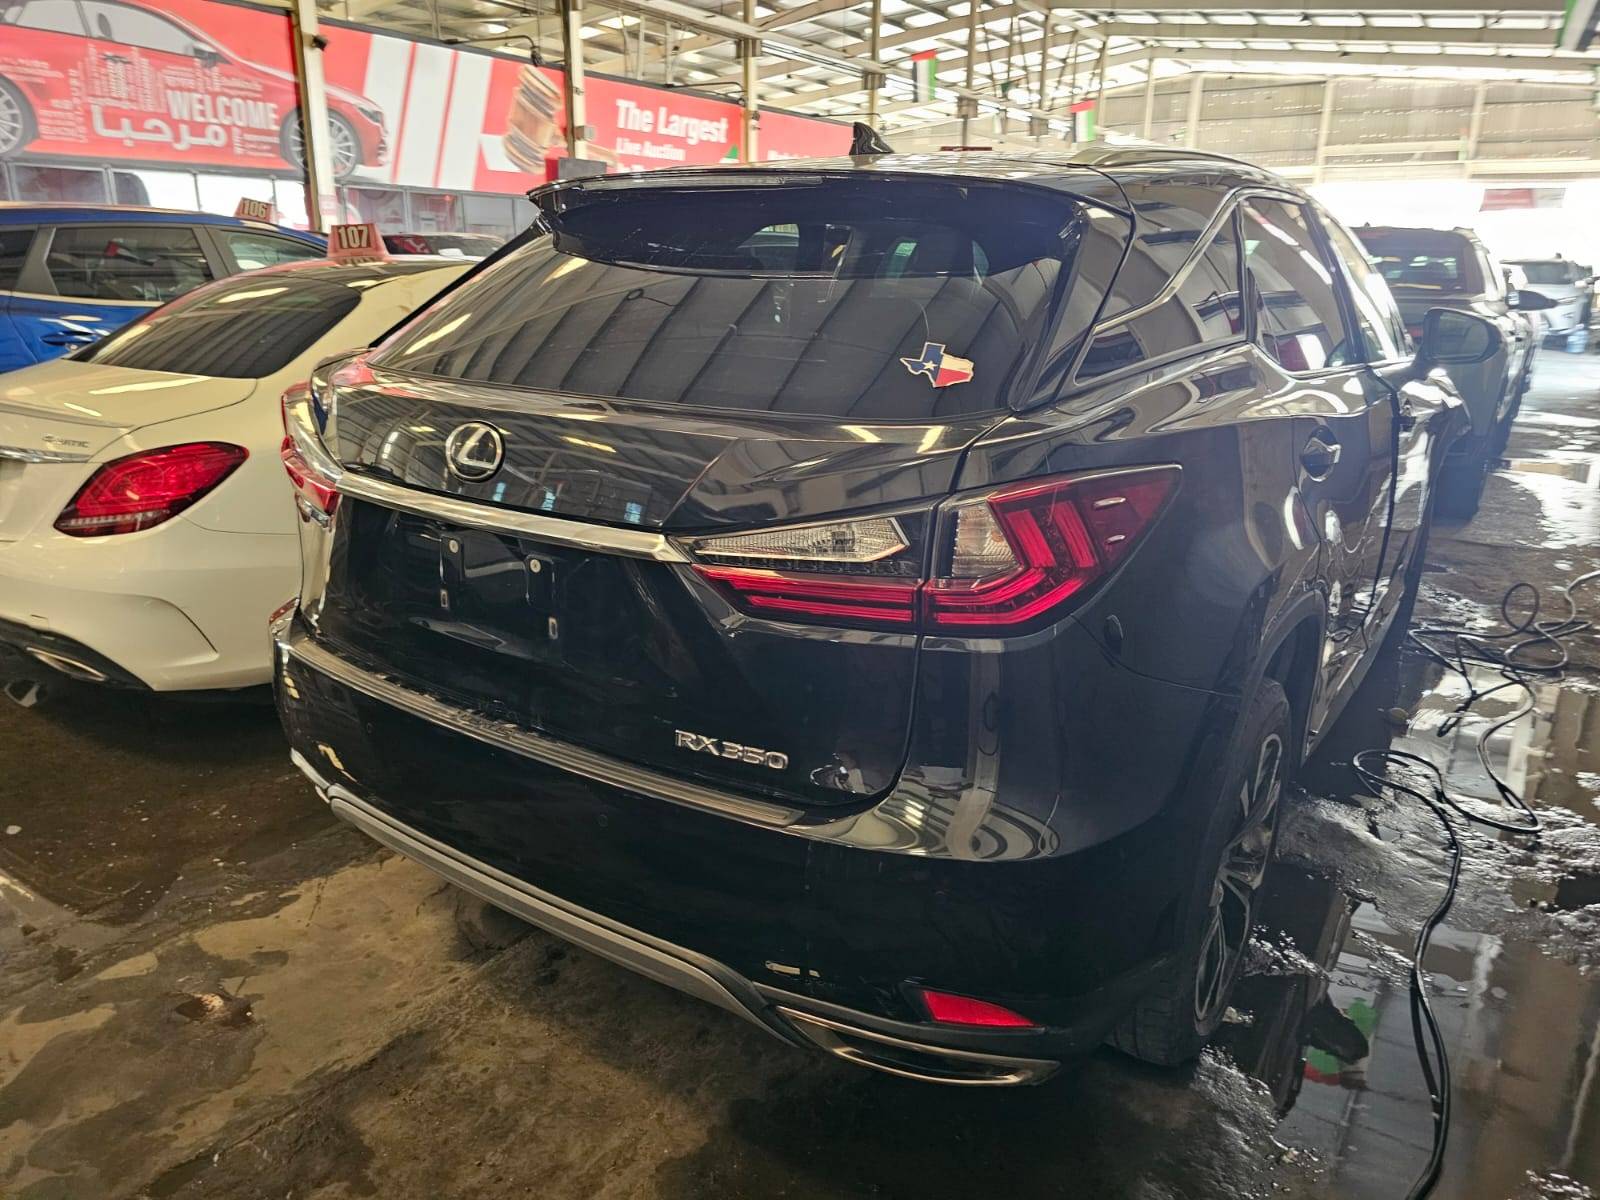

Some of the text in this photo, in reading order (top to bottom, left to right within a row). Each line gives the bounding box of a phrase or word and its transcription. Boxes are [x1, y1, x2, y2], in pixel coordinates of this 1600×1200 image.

[166, 89, 280, 131] WELCOME
[616, 98, 729, 145] The Largest
[90, 104, 228, 151] مرحبا
[616, 137, 642, 156] Live
[242, 200, 268, 219] 106
[338, 225, 369, 249] 107
